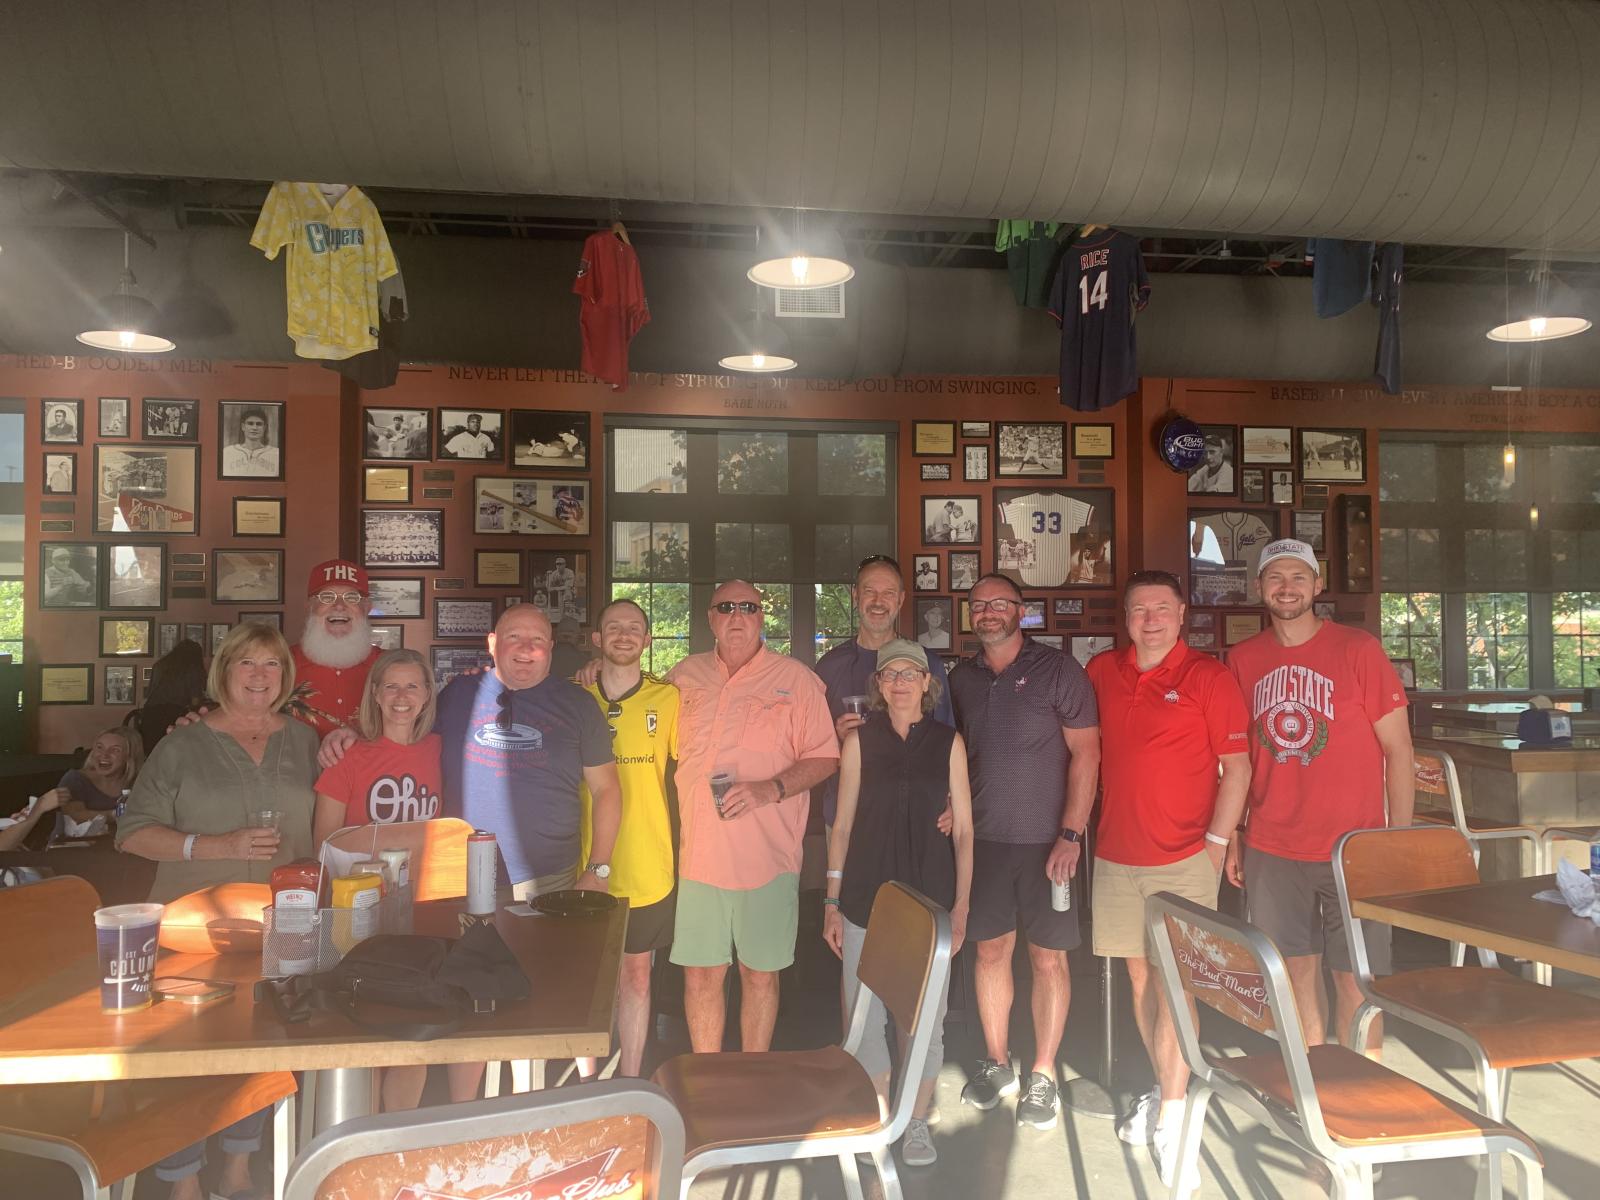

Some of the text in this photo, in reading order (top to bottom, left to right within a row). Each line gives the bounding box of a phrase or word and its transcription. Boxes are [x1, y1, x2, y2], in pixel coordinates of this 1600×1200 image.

[1080, 249, 1110, 270] RICE
[1079, 270, 1108, 314] 14
[448, 366, 509, 381] NEVER
[515, 367, 545, 382] LET
[551, 369, 588, 384] THE
[854, 379, 888, 393] YOU
[894, 379, 942, 394] FROM
[1032, 511, 1062, 535] 33
[324, 565, 358, 582] THE
[1253, 664, 1335, 721] OHIO STATE
[369, 776, 439, 823] Ohio
[285, 893, 304, 901] HEINZ
[1178, 949, 1198, 969] The
[1194, 959, 1221, 983] Bud
[1220, 972, 1252, 998] Man
[562, 1172, 635, 1200] Club
